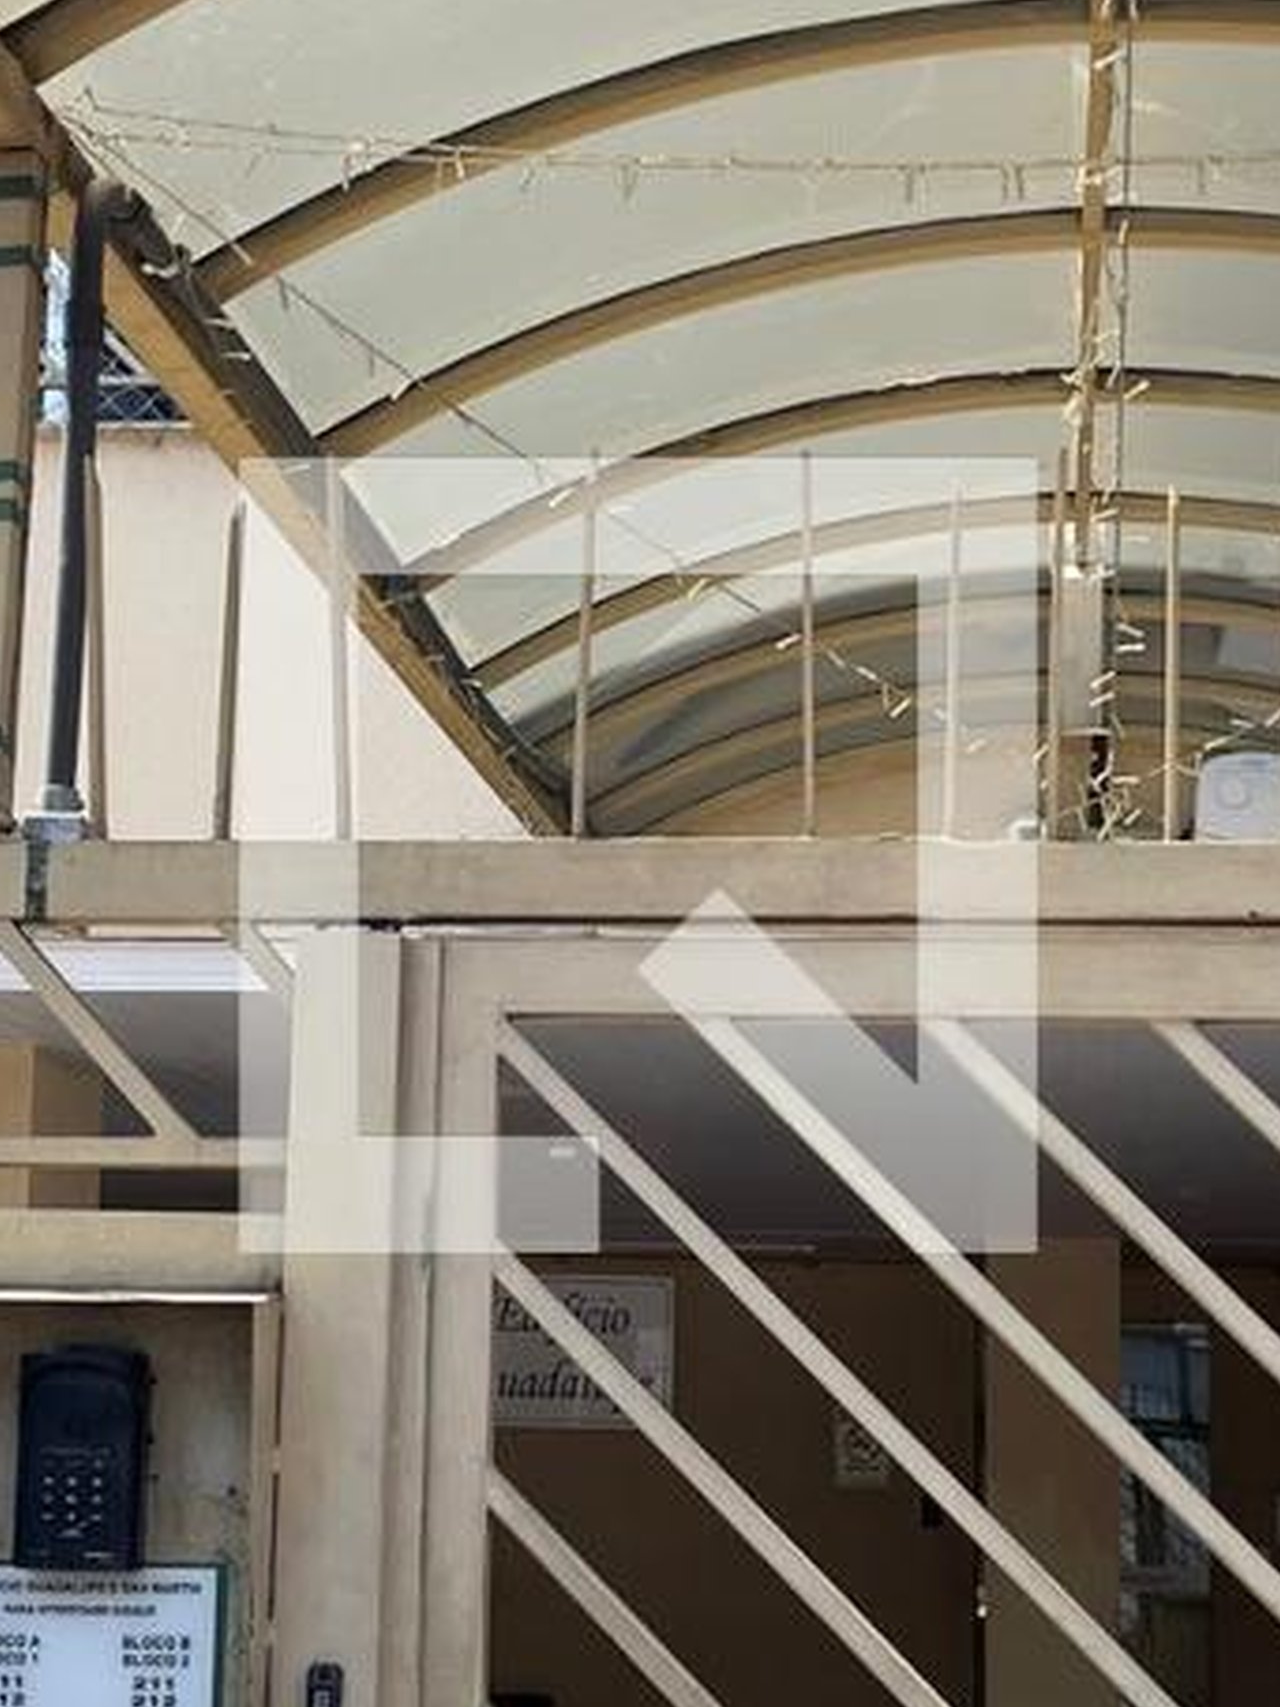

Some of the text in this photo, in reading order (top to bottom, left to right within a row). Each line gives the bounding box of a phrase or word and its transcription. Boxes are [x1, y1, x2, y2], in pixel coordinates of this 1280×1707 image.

[121, 1635, 177, 1651] BLOCO
[121, 1653, 177, 1669] BLOCO
[133, 1676, 175, 1691] 211
